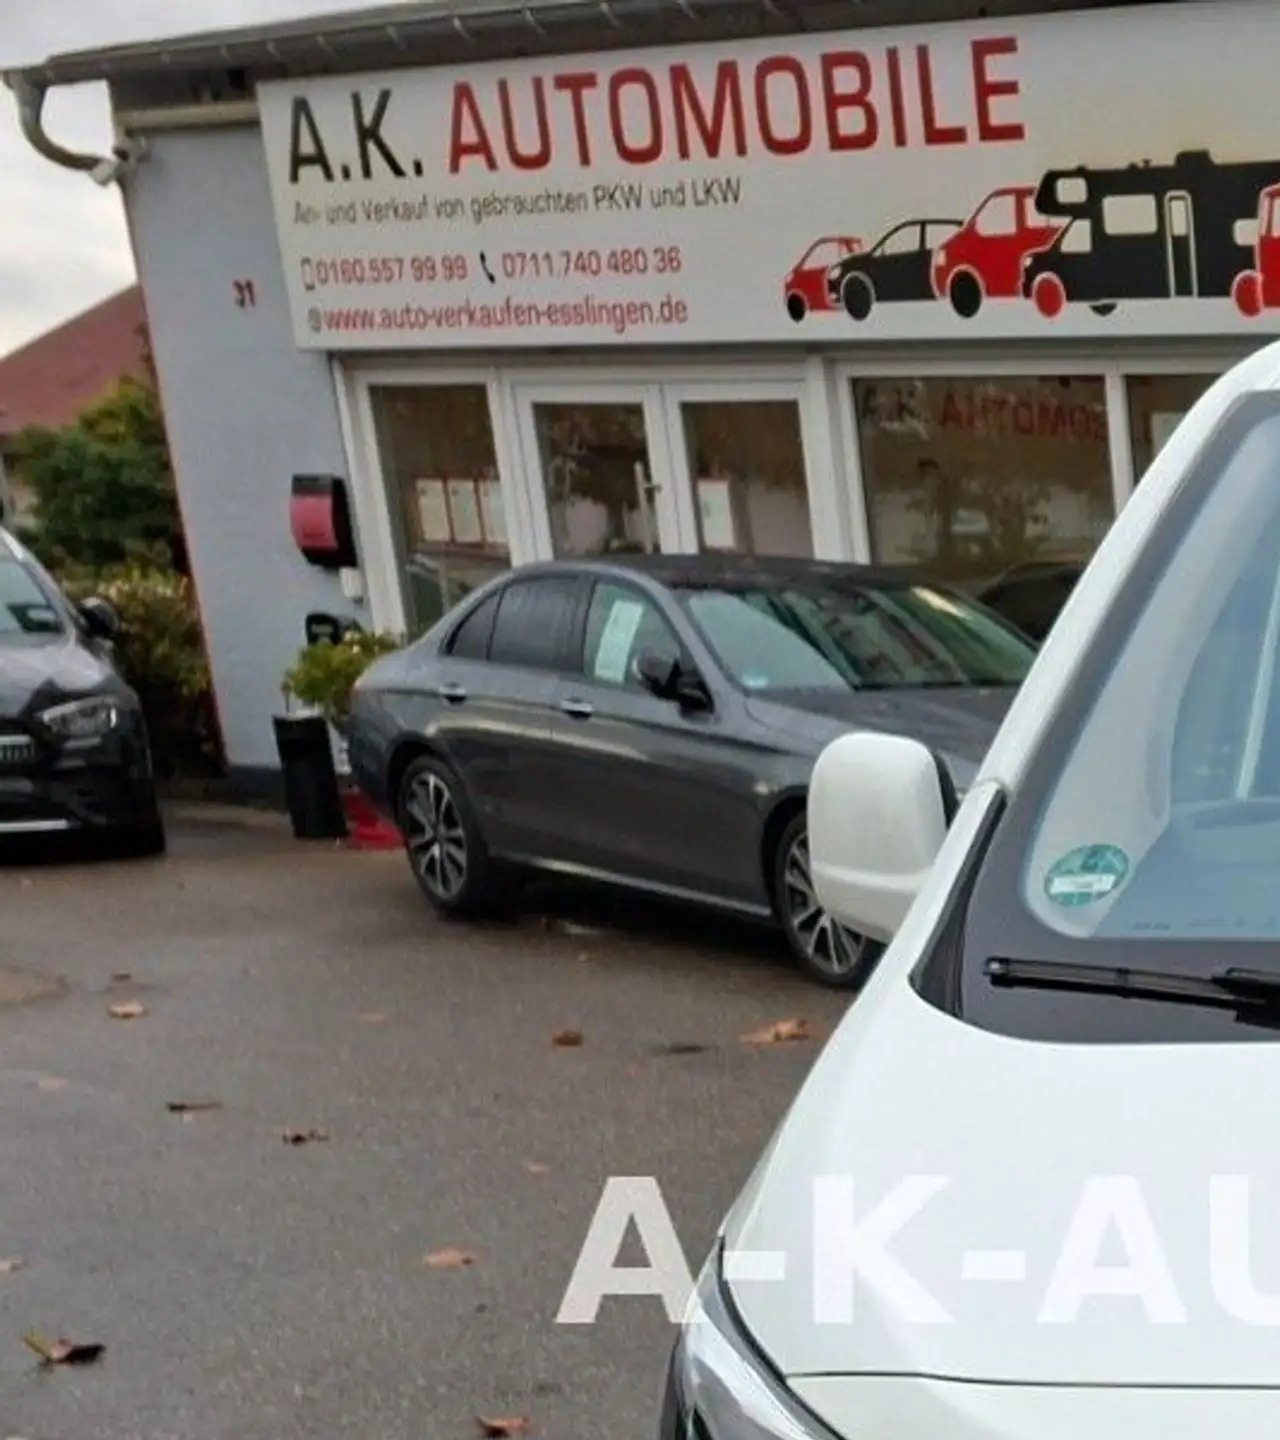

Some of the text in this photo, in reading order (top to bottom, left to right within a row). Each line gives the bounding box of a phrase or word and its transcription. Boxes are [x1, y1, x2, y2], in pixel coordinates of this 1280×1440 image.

[289, 37, 1026, 183] A.K. AUTOMOBILE
[326, 204, 357, 224] und
[361, 195, 428, 222] Verkauf
[433, 198, 464, 220] von
[471, 189, 588, 225] gebrauchten
[592, 183, 643, 211] PKW
[649, 180, 686, 208] und
[690, 177, 741, 206] LKW
[501, 249, 601, 279] 0711.740
[606, 248, 648, 275] 480
[652, 246, 682, 273] 36
[324, 294, 689, 333] www.auto-verkaufen-esslingen.de
